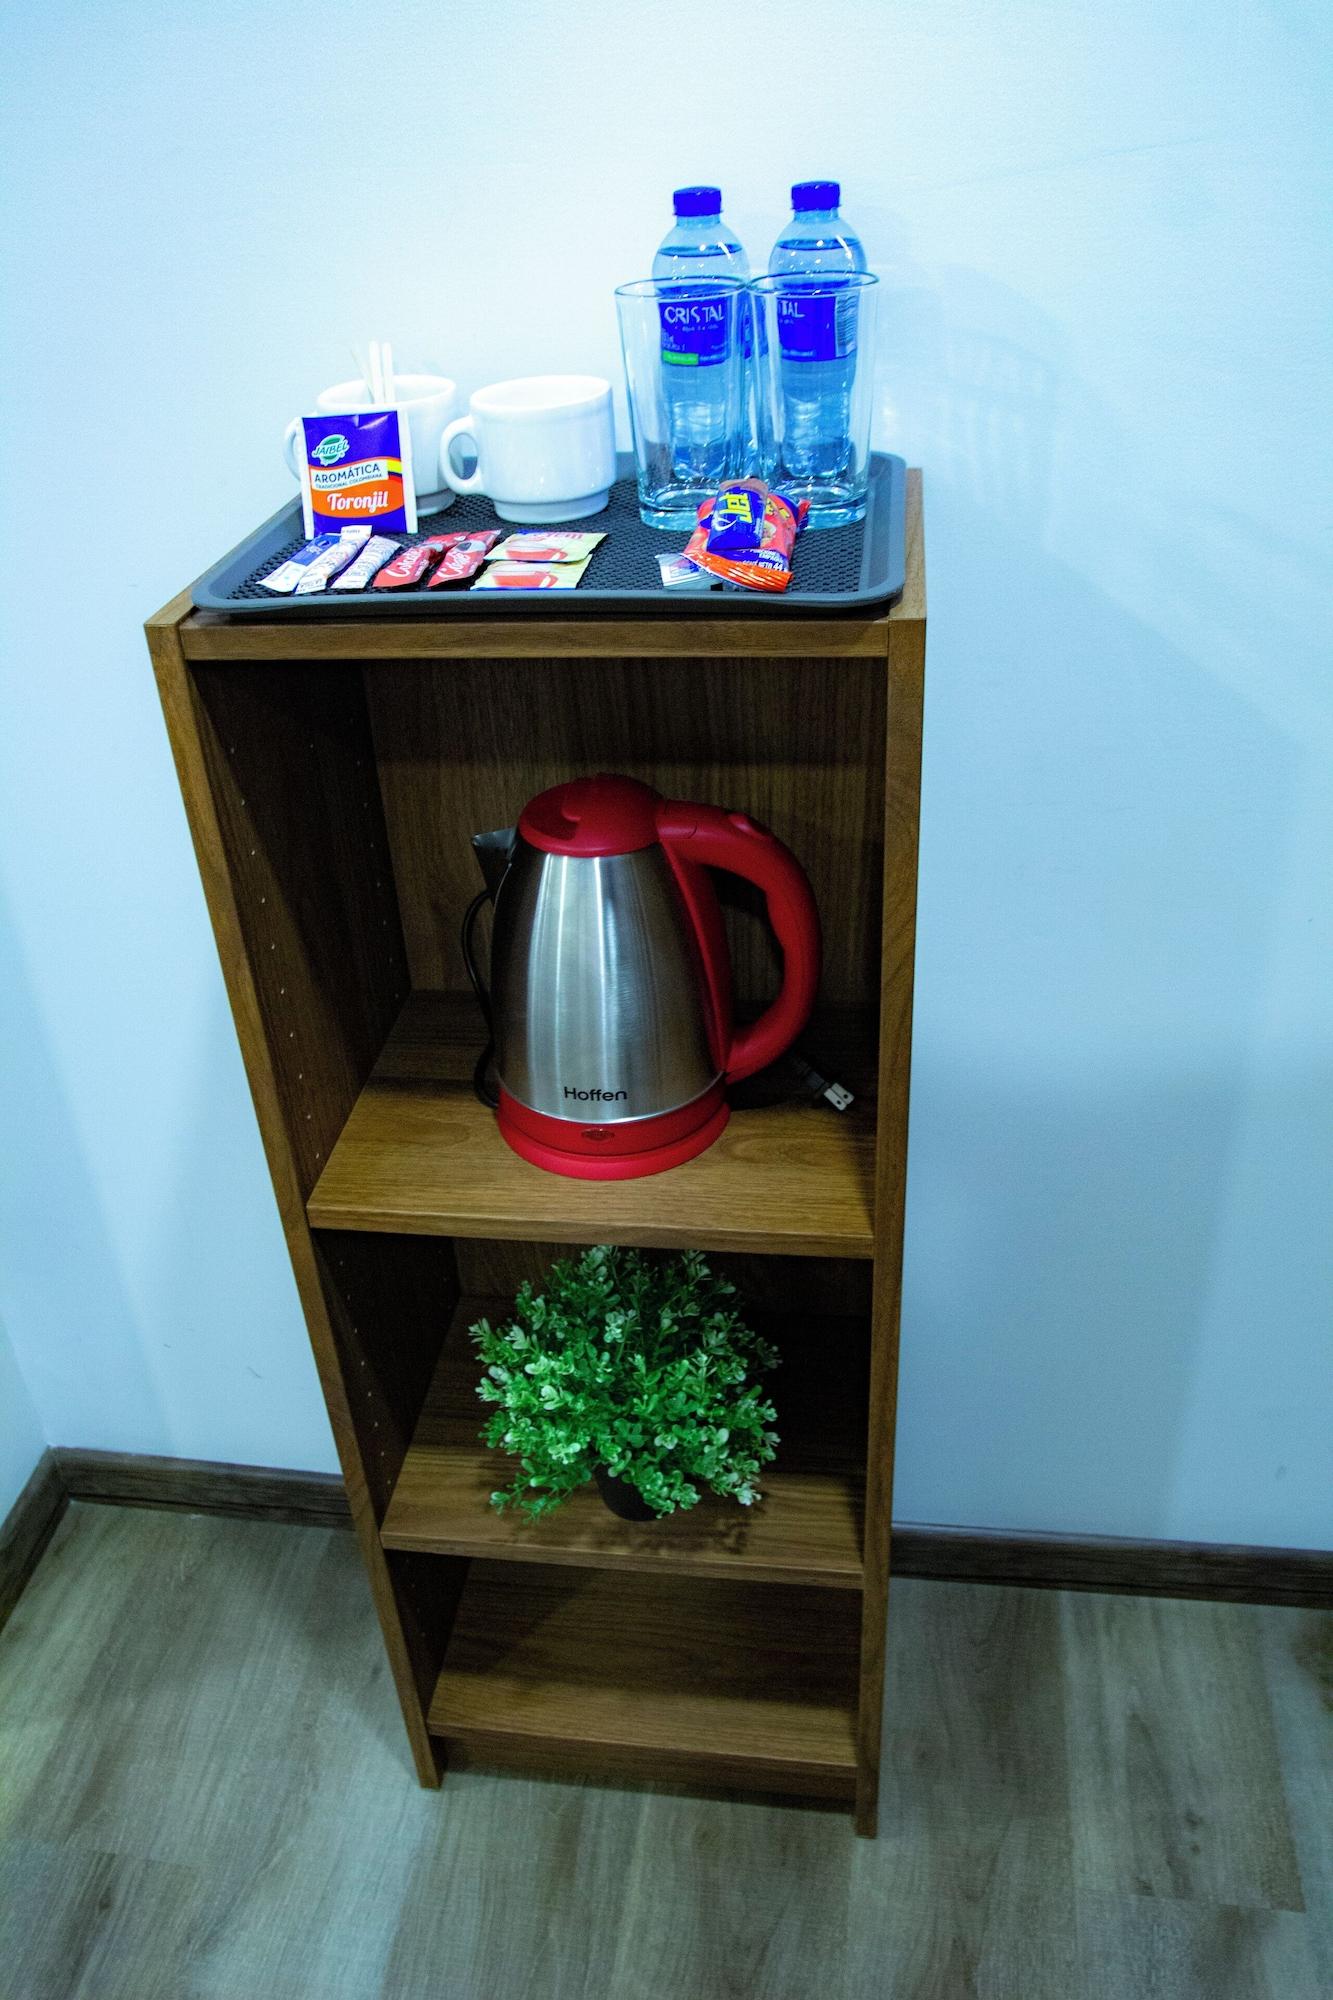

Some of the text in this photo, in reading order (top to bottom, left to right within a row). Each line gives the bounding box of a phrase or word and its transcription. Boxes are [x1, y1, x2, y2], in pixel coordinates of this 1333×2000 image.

[664, 304, 725, 324] CRISTAL
[779, 300, 806, 318] TAL
[313, 441, 348, 456] JAIBEL
[314, 463, 381, 484] AROMÁTICA
[327, 491, 389, 514] Toronjil
[563, 1086, 628, 1102] Hoffen
